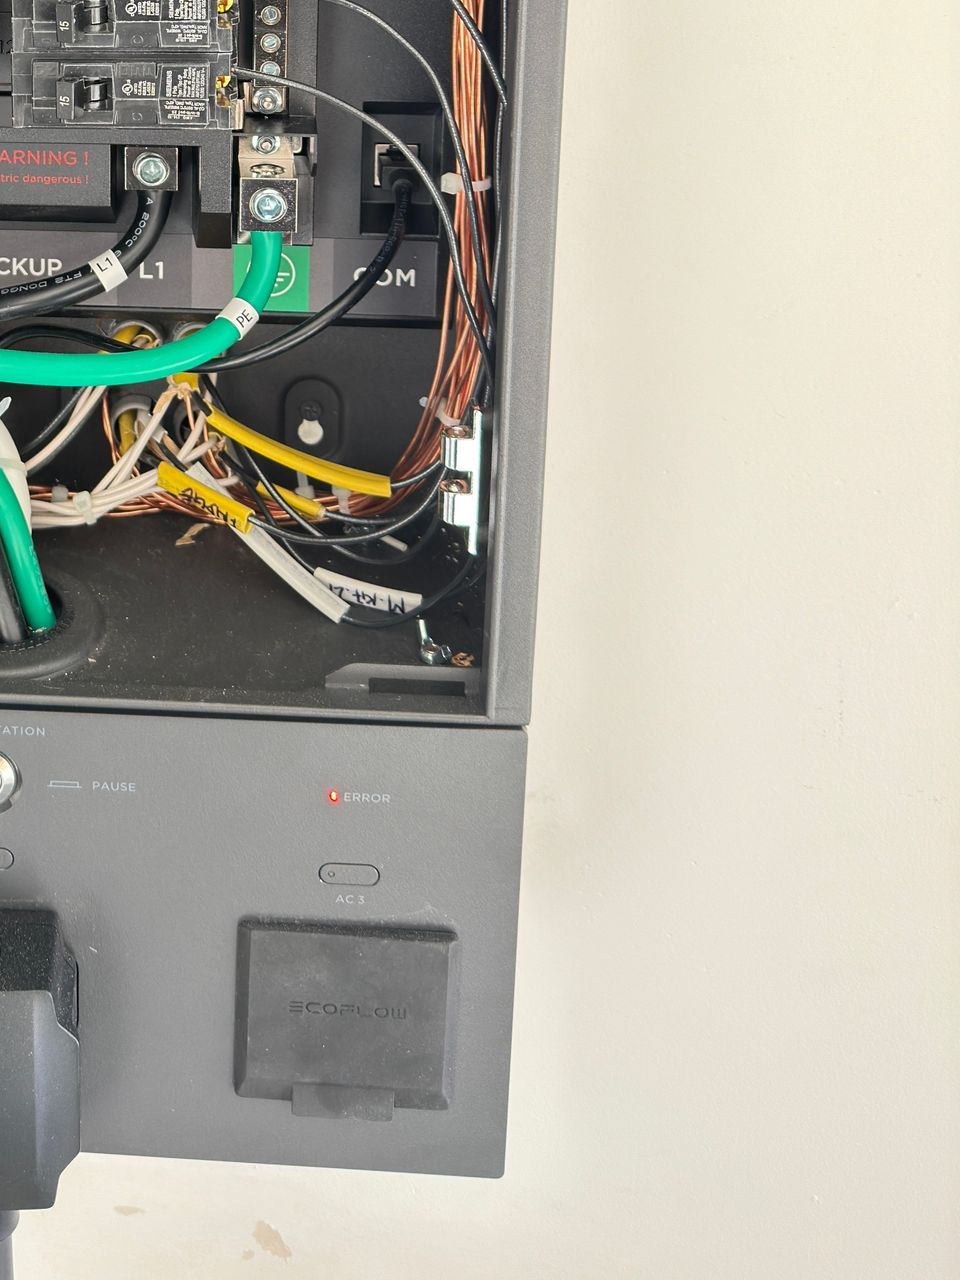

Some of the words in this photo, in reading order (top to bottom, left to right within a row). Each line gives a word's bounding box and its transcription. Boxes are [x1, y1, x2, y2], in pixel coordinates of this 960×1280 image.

[60, 21, 69, 32] 15
[60, 96, 70, 107] 15
[22, 173, 81, 187] dangerous
[97, 257, 113, 272] L1
[139, 261, 164, 279] L1
[354, 267, 416, 288] COM
[237, 309, 254, 328] PE
[92, 781, 136, 792] PAUSE
[343, 792, 390, 804] ERROR
[335, 894, 354, 904] AC
[358, 895, 365, 905] 3
[289, 1000, 407, 1020] ECOFLOW
